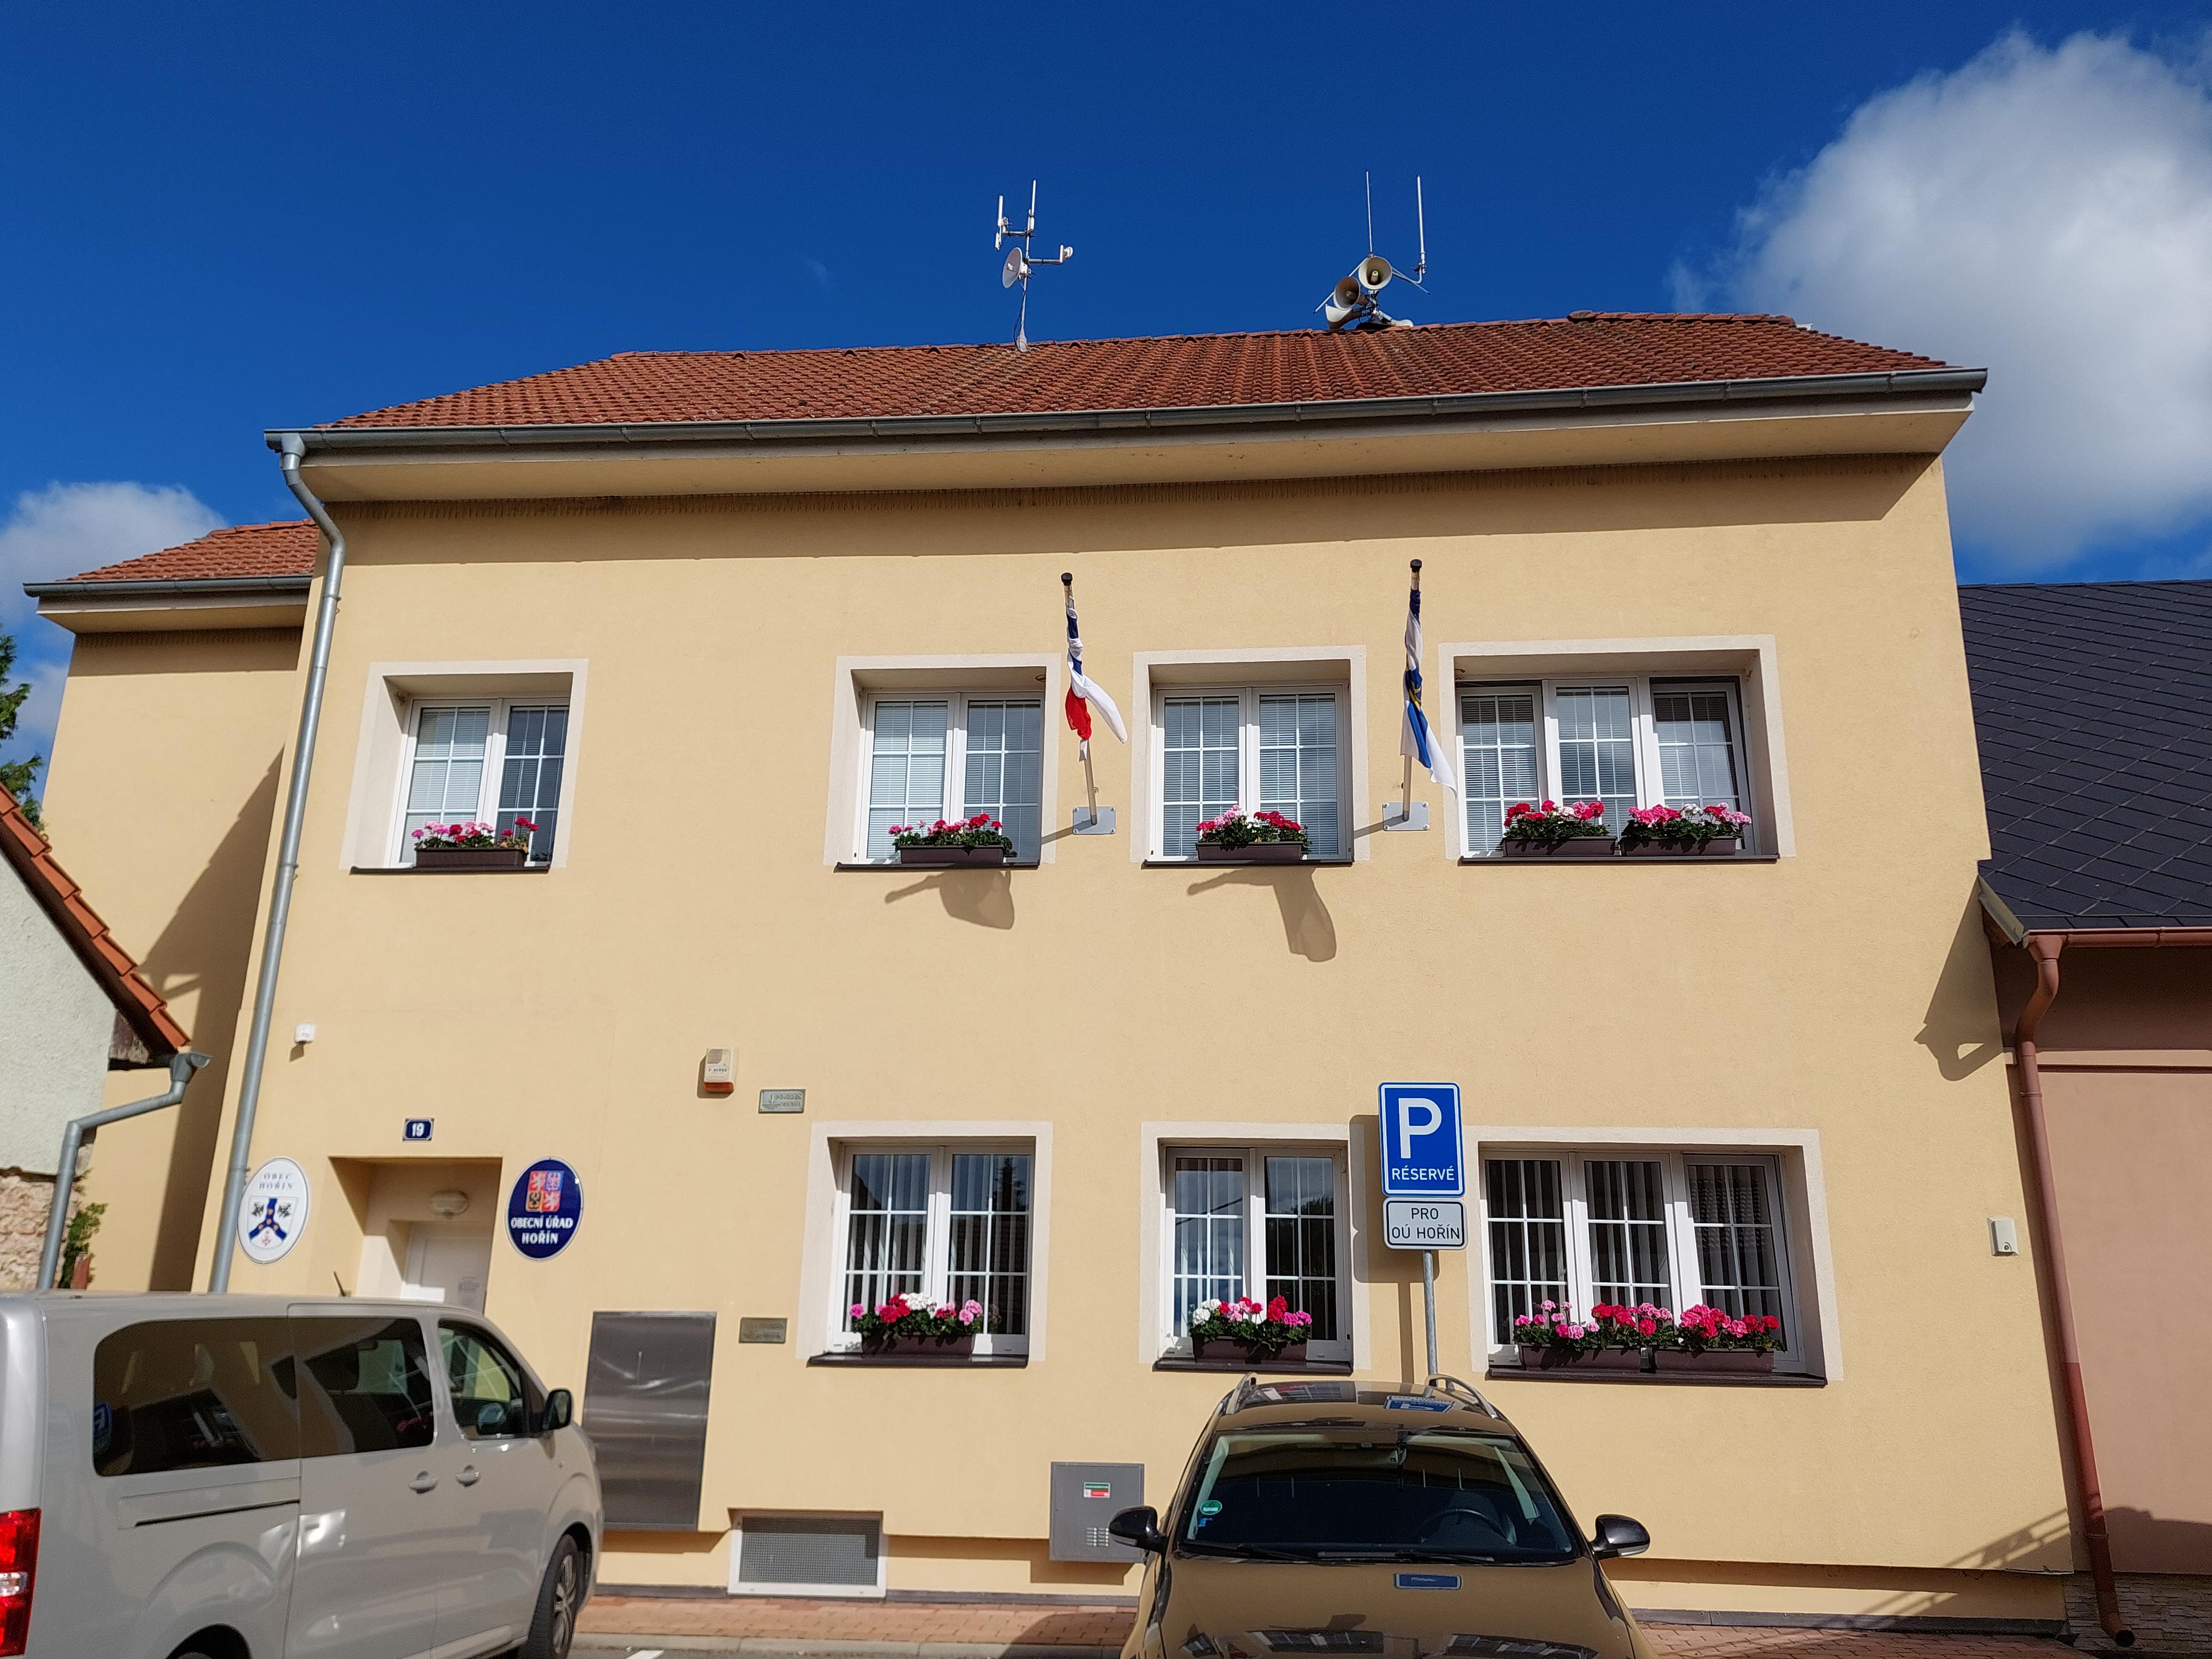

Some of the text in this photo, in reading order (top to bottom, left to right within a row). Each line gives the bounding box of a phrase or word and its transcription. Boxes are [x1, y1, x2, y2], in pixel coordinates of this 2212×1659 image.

[412, 1123, 425, 1137] 19
[1398, 1097, 1442, 1159] P
[1391, 1165, 1455, 1181] RÉSERVÉ
[1411, 1207, 1439, 1220] PRO
[510, 1214, 574, 1229] OBECNÍ ÚŘAD
[521, 1229, 559, 1244] HOŘÍN
[1391, 1223, 1460, 1239] OÚ HOŘÍN
